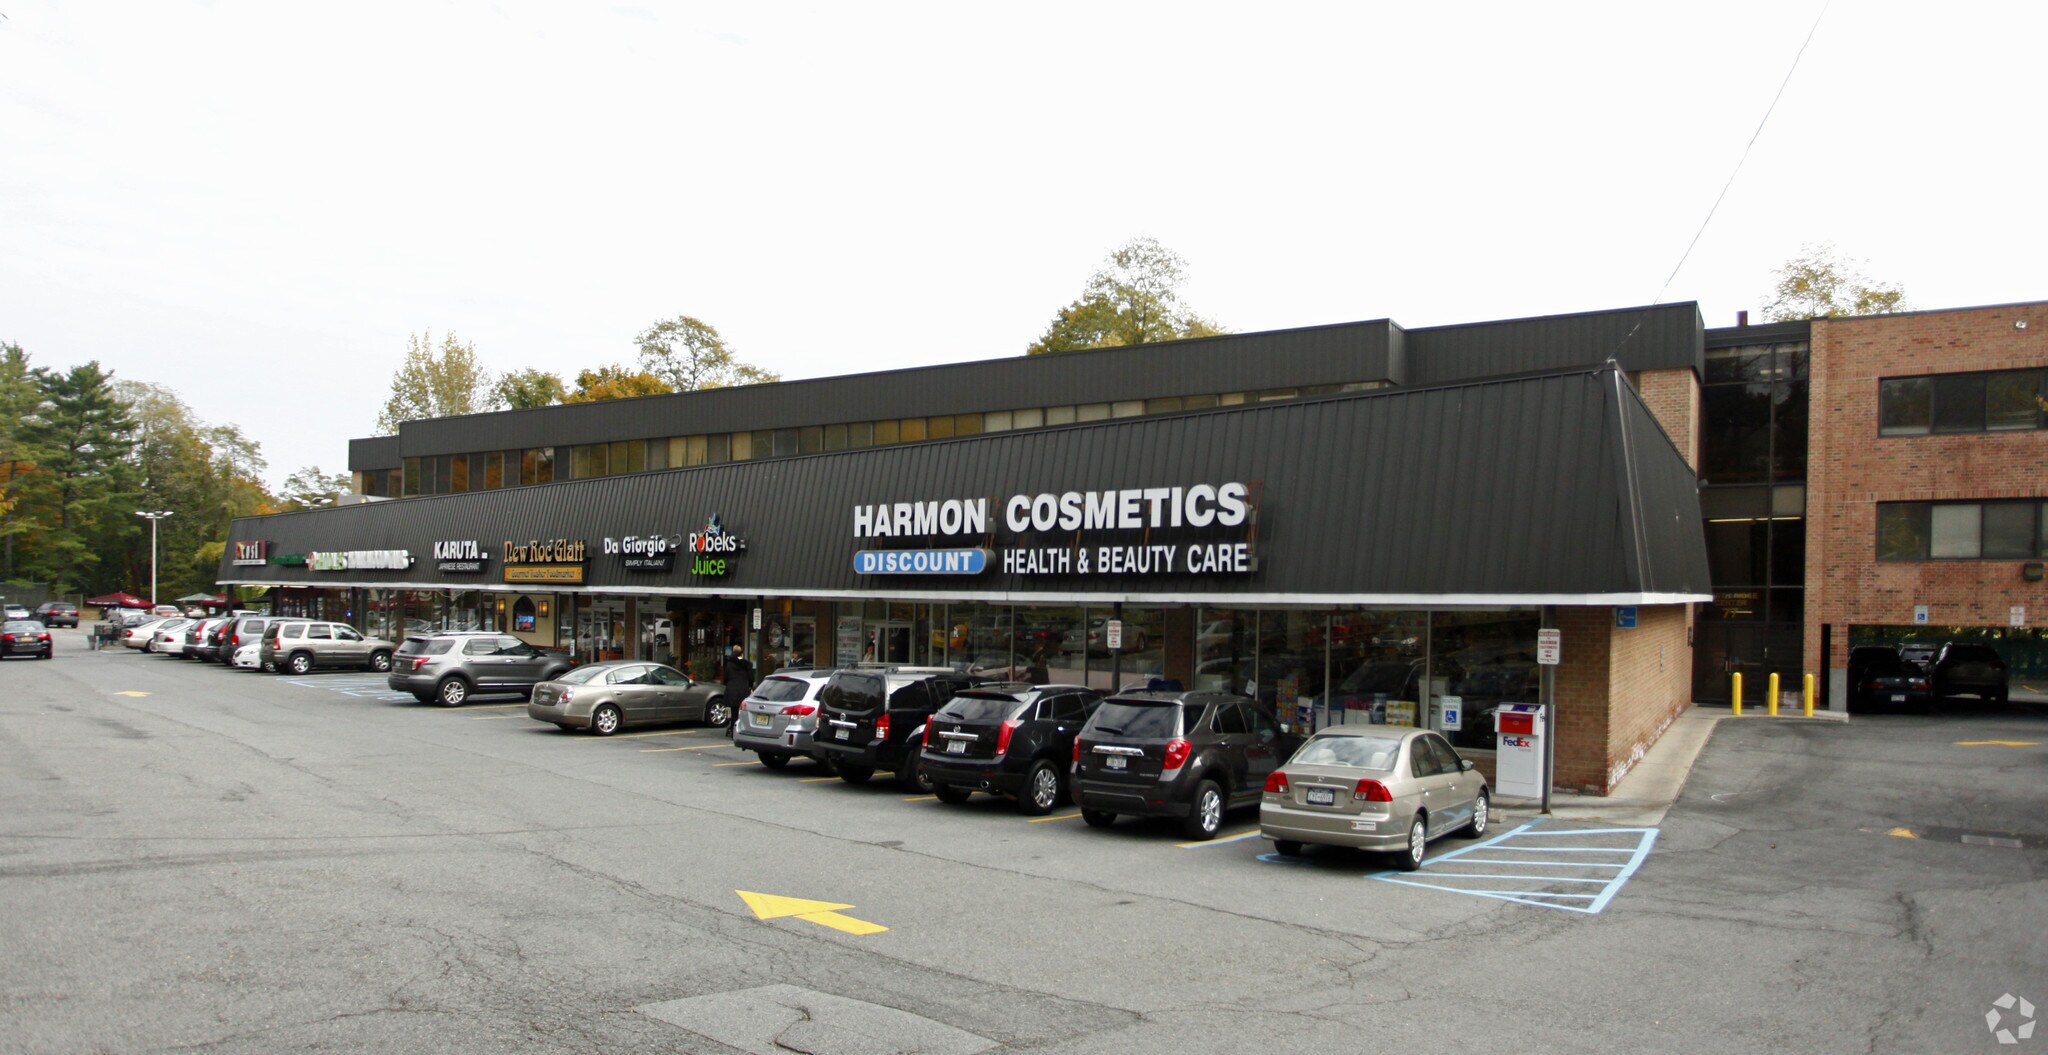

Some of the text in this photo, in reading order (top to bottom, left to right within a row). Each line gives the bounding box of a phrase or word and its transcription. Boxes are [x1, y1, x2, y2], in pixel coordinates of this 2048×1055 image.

[854, 482, 1249, 538] HARMON COSMETICS
[434, 541, 478, 559] KARUTA
[503, 540, 528, 562] New
[554, 538, 585, 562] Glatt
[604, 535, 666, 558] Da Giorgio
[689, 531, 736, 554] Robeks
[691, 555, 726, 576] Juice
[863, 551, 974, 572] DISCOUNT
[1004, 544, 1248, 574] HEALTH & BEAUTY CARE
[1503, 736, 1530, 747] FedEx
